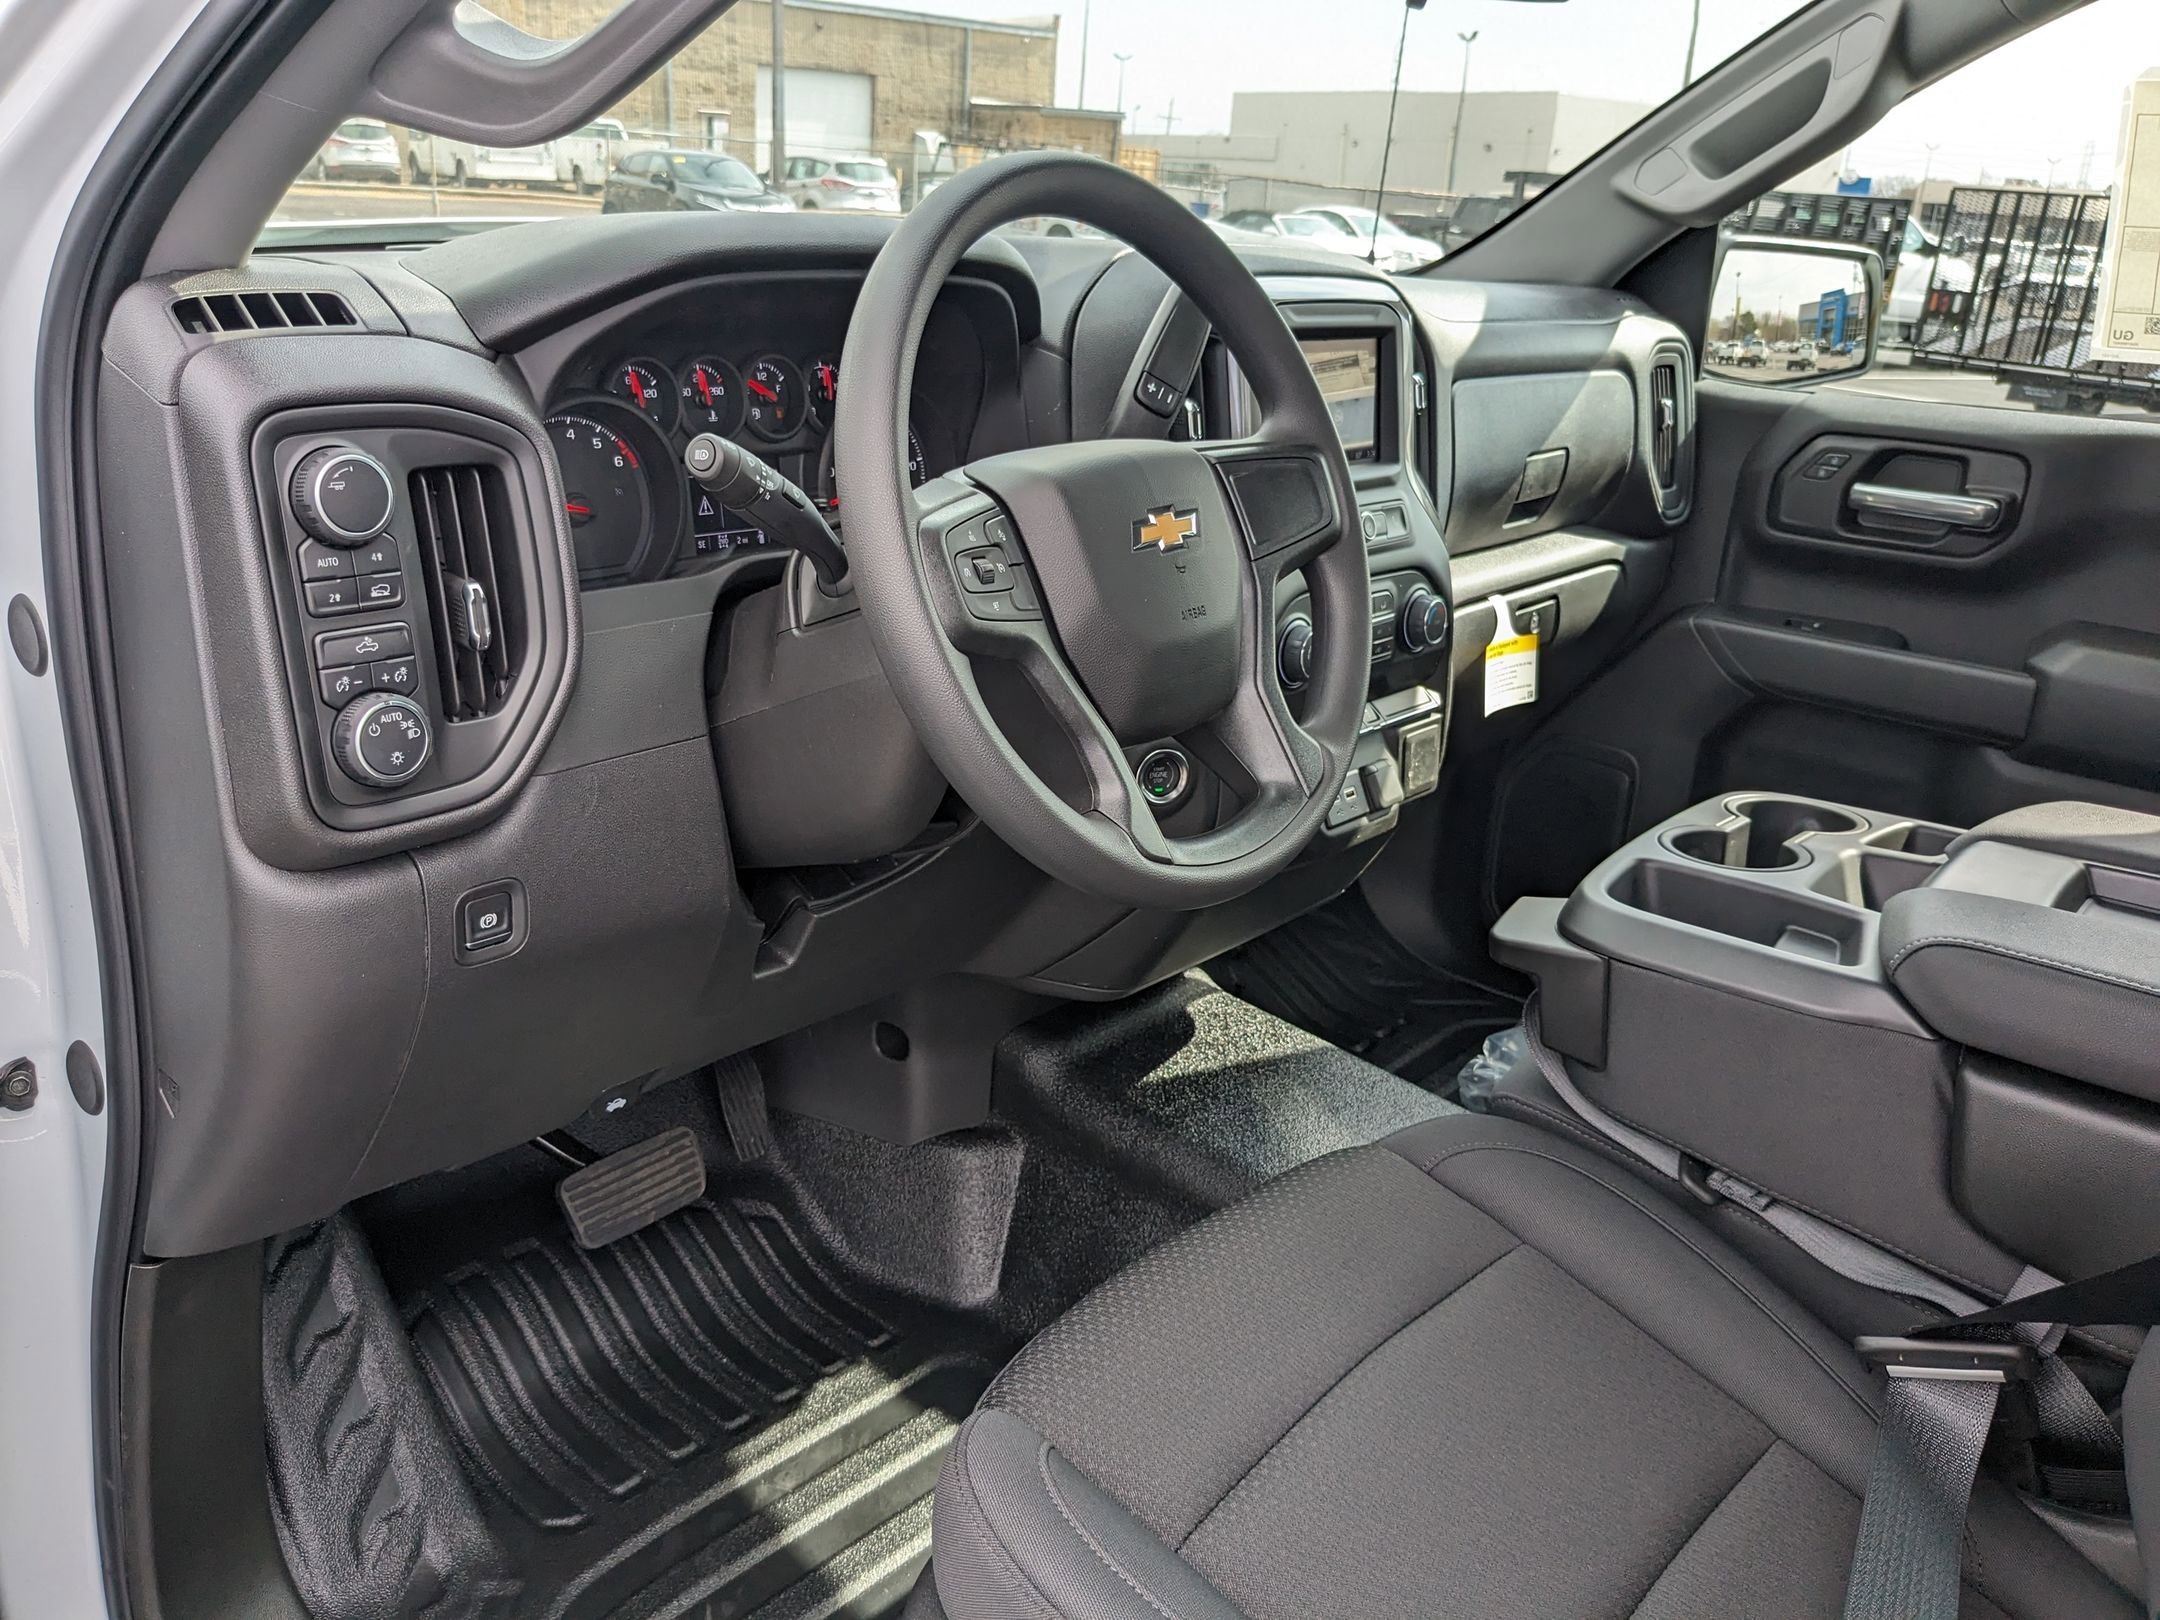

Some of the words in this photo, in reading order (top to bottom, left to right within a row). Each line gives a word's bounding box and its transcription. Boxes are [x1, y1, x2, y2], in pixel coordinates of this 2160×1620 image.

[643, 388, 657, 398] 120
[709, 386, 724, 396] 260
[776, 384, 781, 393] F
[566, 429, 575, 440] 4
[592, 438, 602, 449] 5
[614, 455, 624, 467] 6
[697, 539, 706, 549] SE
[317, 557, 339, 568] AUTO
[1181, 604, 1207, 620] AIRBAG
[380, 711, 403, 724] AUTO
